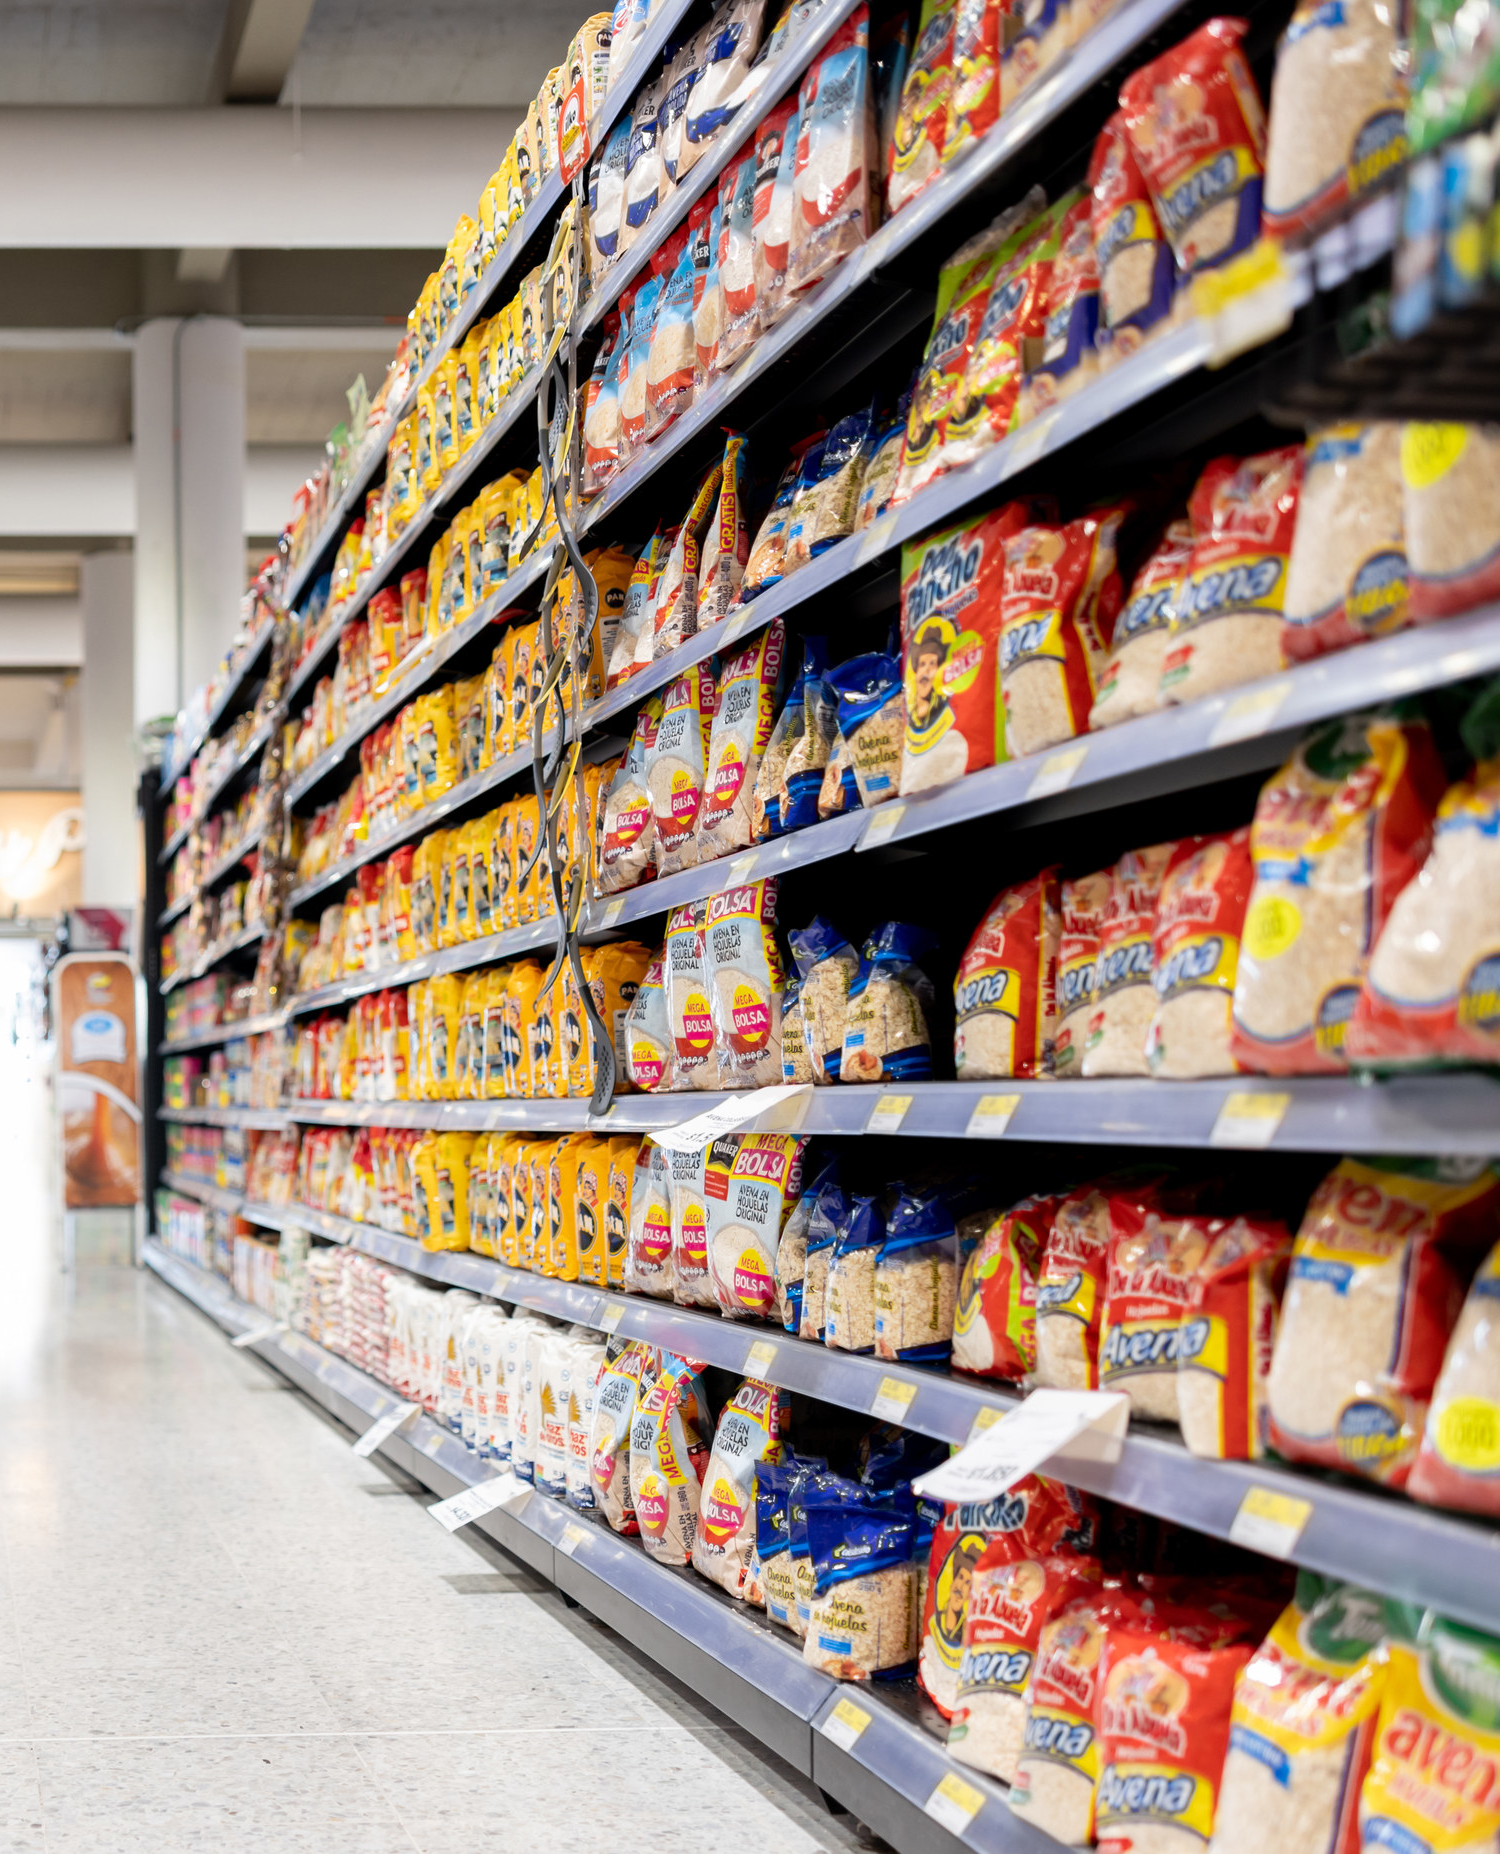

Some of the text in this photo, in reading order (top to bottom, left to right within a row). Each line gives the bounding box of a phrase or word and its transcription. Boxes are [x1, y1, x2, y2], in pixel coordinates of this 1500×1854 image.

[720, 494, 735, 551] GRATIS
[763, 620, 786, 678] BOLSA
[942, 646, 983, 684] BOLSA
[677, 715, 686, 724] EN
[756, 693, 775, 749] MEGA
[659, 724, 686, 743] HOJUELAS
[857, 734, 891, 752] Avena
[674, 778, 689, 790] MEGA
[714, 767, 740, 787] BOLSA
[672, 793, 697, 811] BOLSA
[616, 811, 644, 827] BOLSA
[713, 924, 740, 941] AVENA EN
[671, 938, 689, 950] AVENA
[713, 936, 741, 953] HOJUELAS
[766, 925, 786, 985] MEGA
[671, 959, 700, 971] ORIGINAL
[734, 993, 754, 1006] MEGA
[687, 1004, 705, 1013] MEGA
[685, 1019, 713, 1033] BOLSA
[734, 1009, 767, 1028] BOLSA
[632, 1050, 653, 1060] MEGA
[713, 1141, 739, 1157] QUAKER
[672, 1160, 700, 1170] HOJUELAS
[734, 1152, 787, 1180] BOLSA
[739, 1185, 770, 1200] AVENA EN
[736, 1198, 769, 1213] HOJUELAS
[647, 1212, 664, 1223] MEGA
[735, 1207, 766, 1225] ORIGINAL
[643, 1228, 671, 1244] BOLSA
[741, 1257, 760, 1273] MEGA
[734, 1274, 770, 1293] BOLSA
[546, 1420, 565, 1435] haz
[739, 1423, 750, 1434] EN
[660, 1434, 683, 1479] MEGA
[1096, 1760, 1197, 1815] Avena
